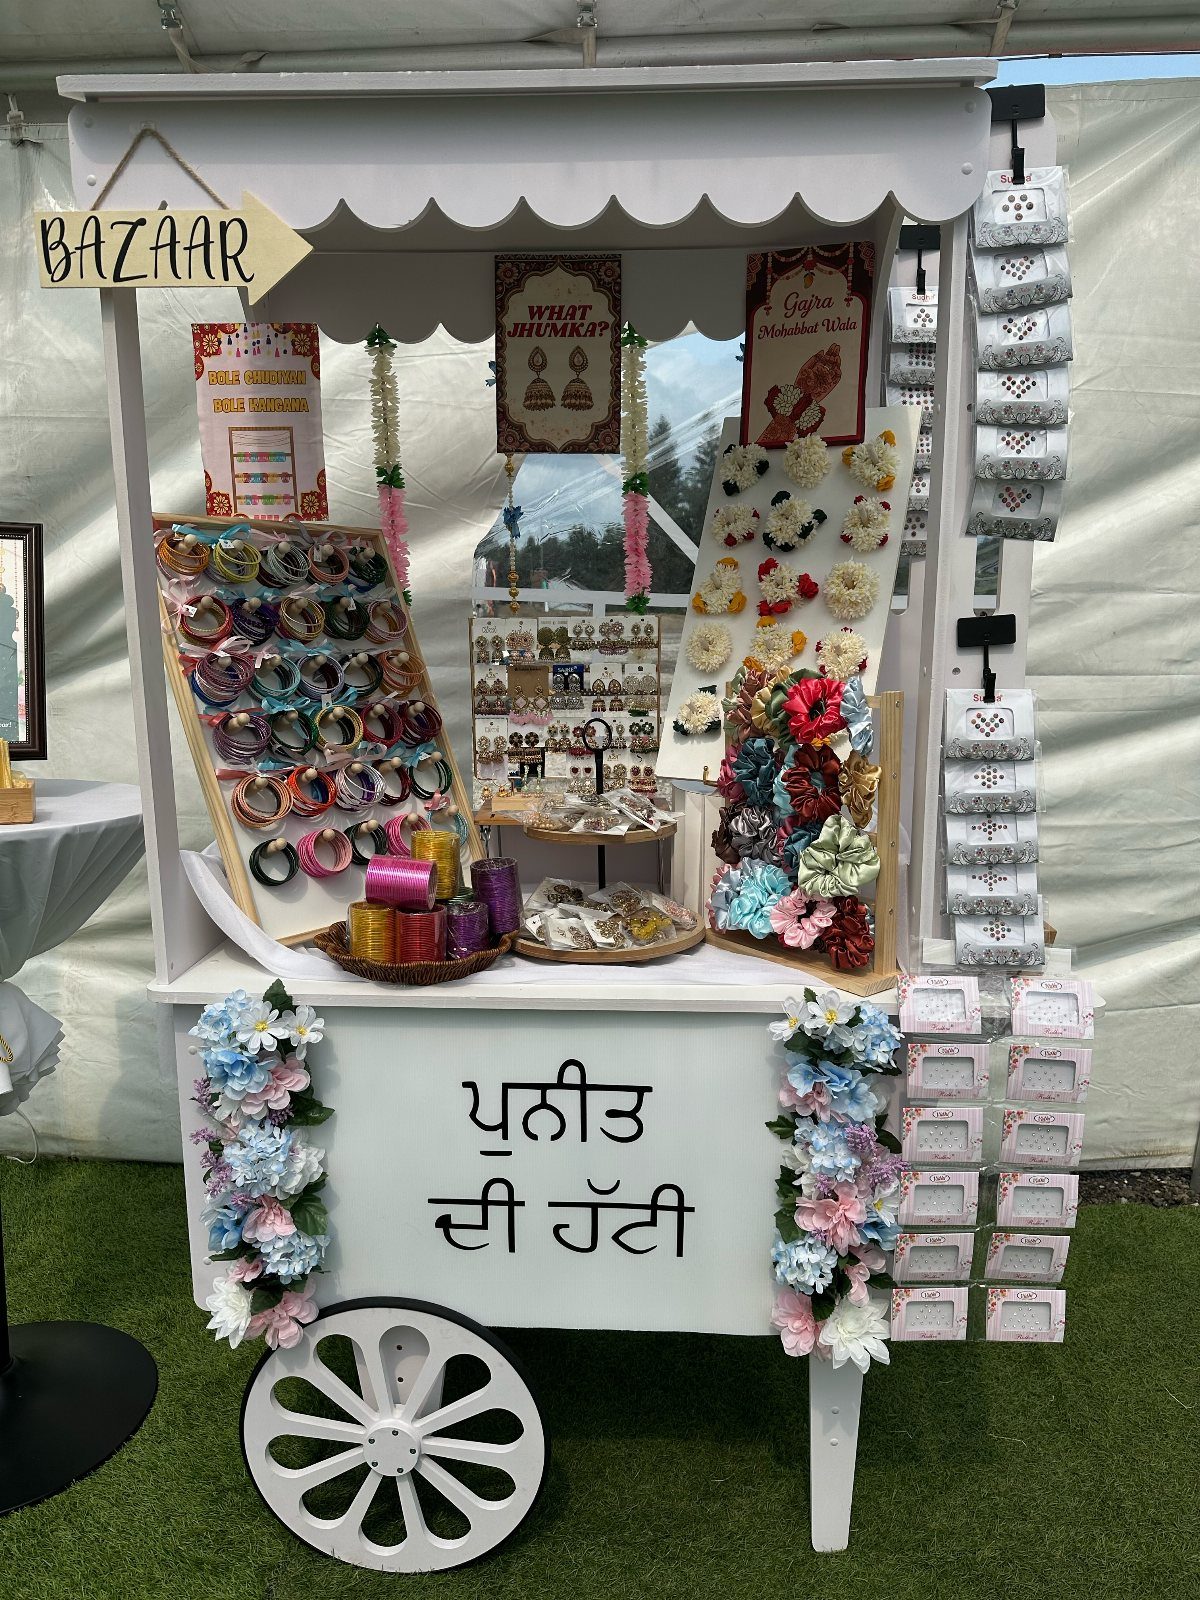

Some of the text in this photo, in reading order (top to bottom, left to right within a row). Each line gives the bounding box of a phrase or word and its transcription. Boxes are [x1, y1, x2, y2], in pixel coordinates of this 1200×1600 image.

[1000, 174, 1032, 184] Sua
[41, 215, 255, 283] BAZAAR
[528, 305, 593, 321] WHAT
[783, 291, 835, 319] Gajra
[507, 321, 610, 338] JHUMKA?
[757, 317, 858, 340] Mohabbat Wala
[208, 370, 307, 385] BOLE CHUDIYAN
[213, 398, 309, 413] BOLE KANGANA
[972, 693, 1002, 702] Sua
[462, 1058, 653, 1157] ਪੁਨੀਤ
[427, 1177, 696, 1258] ਦੀ ਹੱਟੀ
